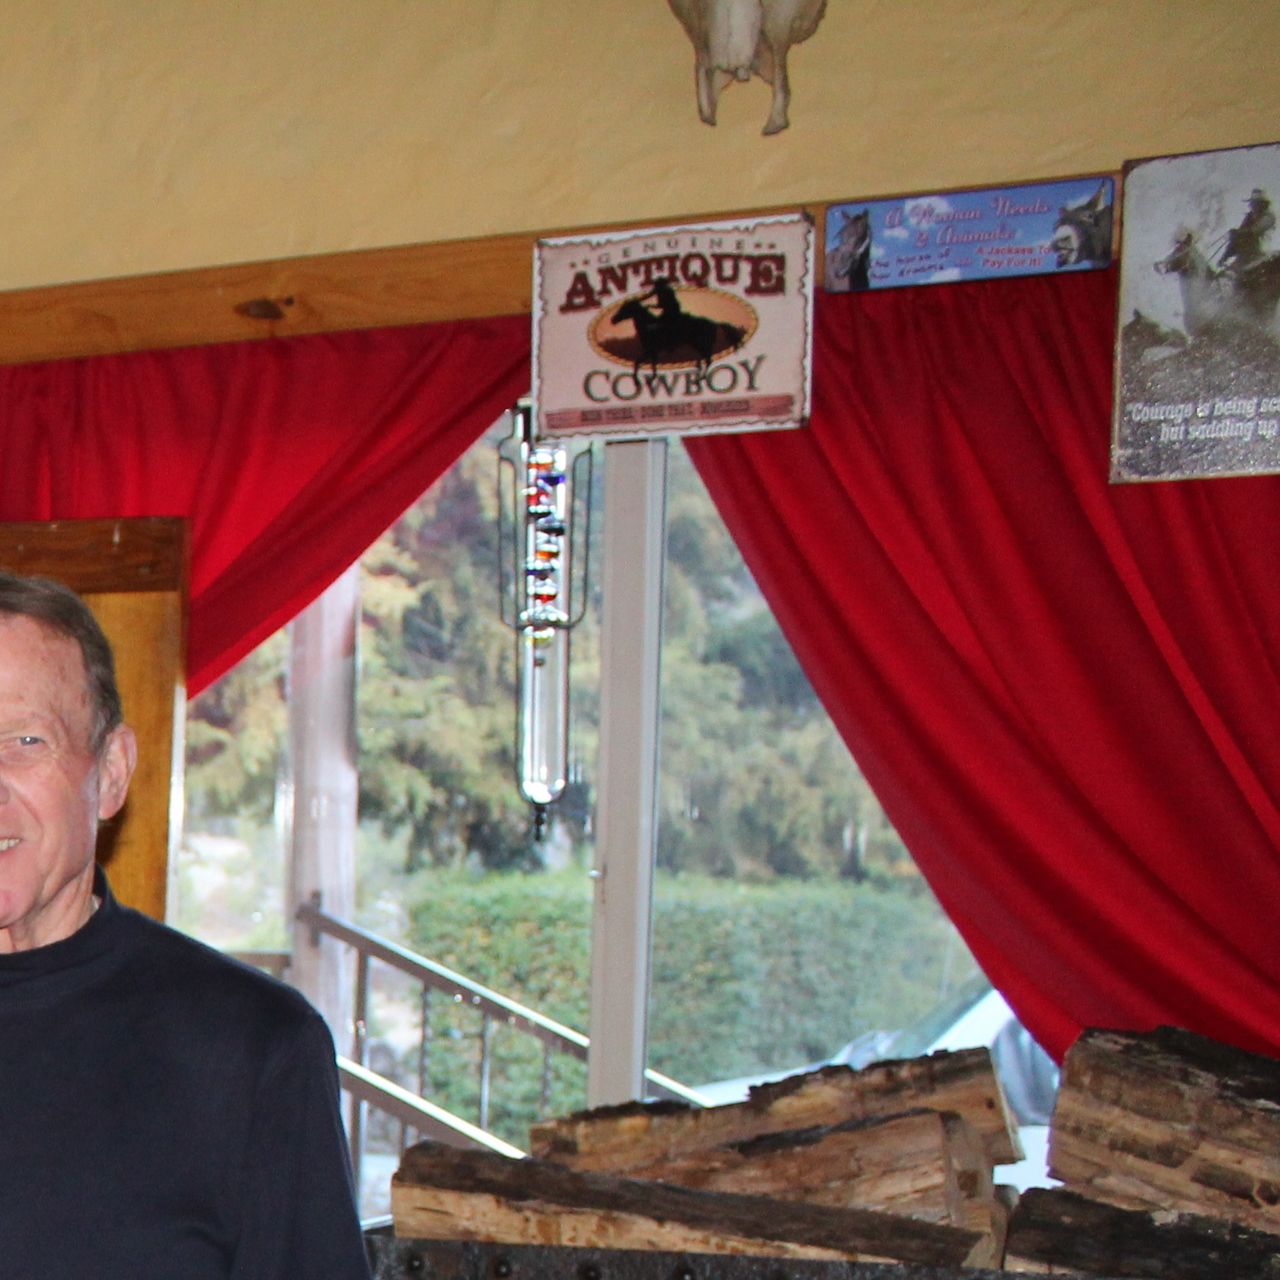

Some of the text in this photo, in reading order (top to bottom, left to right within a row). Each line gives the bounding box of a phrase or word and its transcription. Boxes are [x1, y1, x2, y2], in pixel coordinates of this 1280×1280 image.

[598, 237, 746, 264] GENUINE
[560, 252, 786, 314] ANTIQUE
[584, 354, 767, 402] COWBOY
